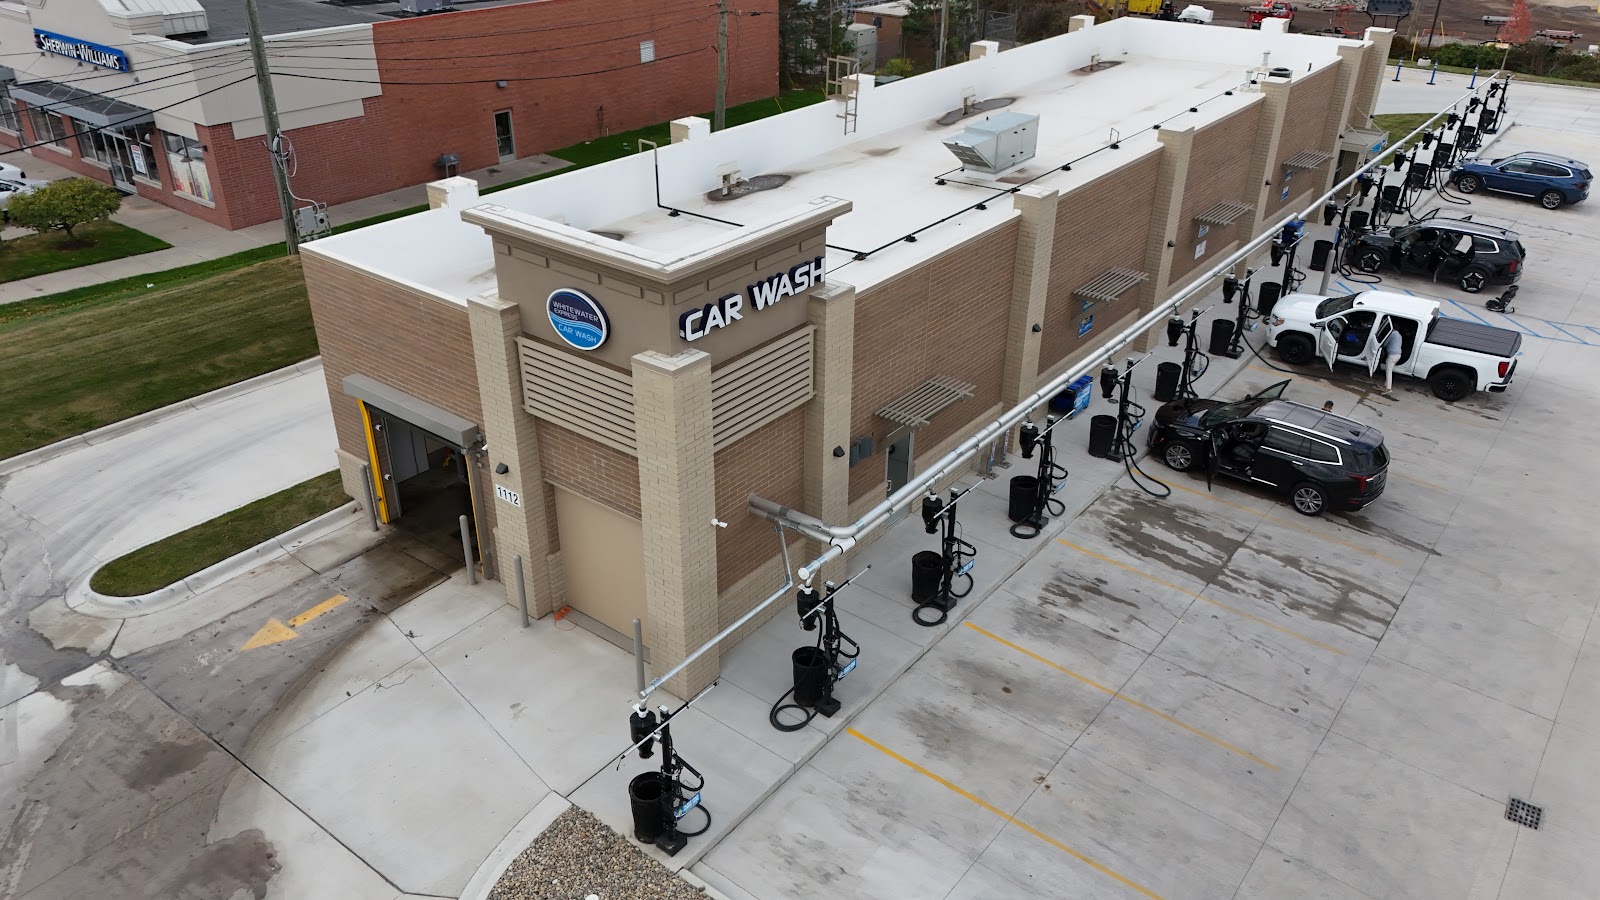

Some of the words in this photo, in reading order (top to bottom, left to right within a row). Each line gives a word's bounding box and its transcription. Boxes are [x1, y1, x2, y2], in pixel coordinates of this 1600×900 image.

[40, 34, 120, 70] SHERWIN-WILLIAMS
[683, 294, 744, 342] CAR
[751, 256, 826, 311] WASH
[552, 300, 599, 323] WHITEWATER
[553, 307, 578, 321] EXPRESS
[558, 324, 574, 335] CAR
[575, 329, 597, 344] WASH
[497, 486, 519, 506] 1112
